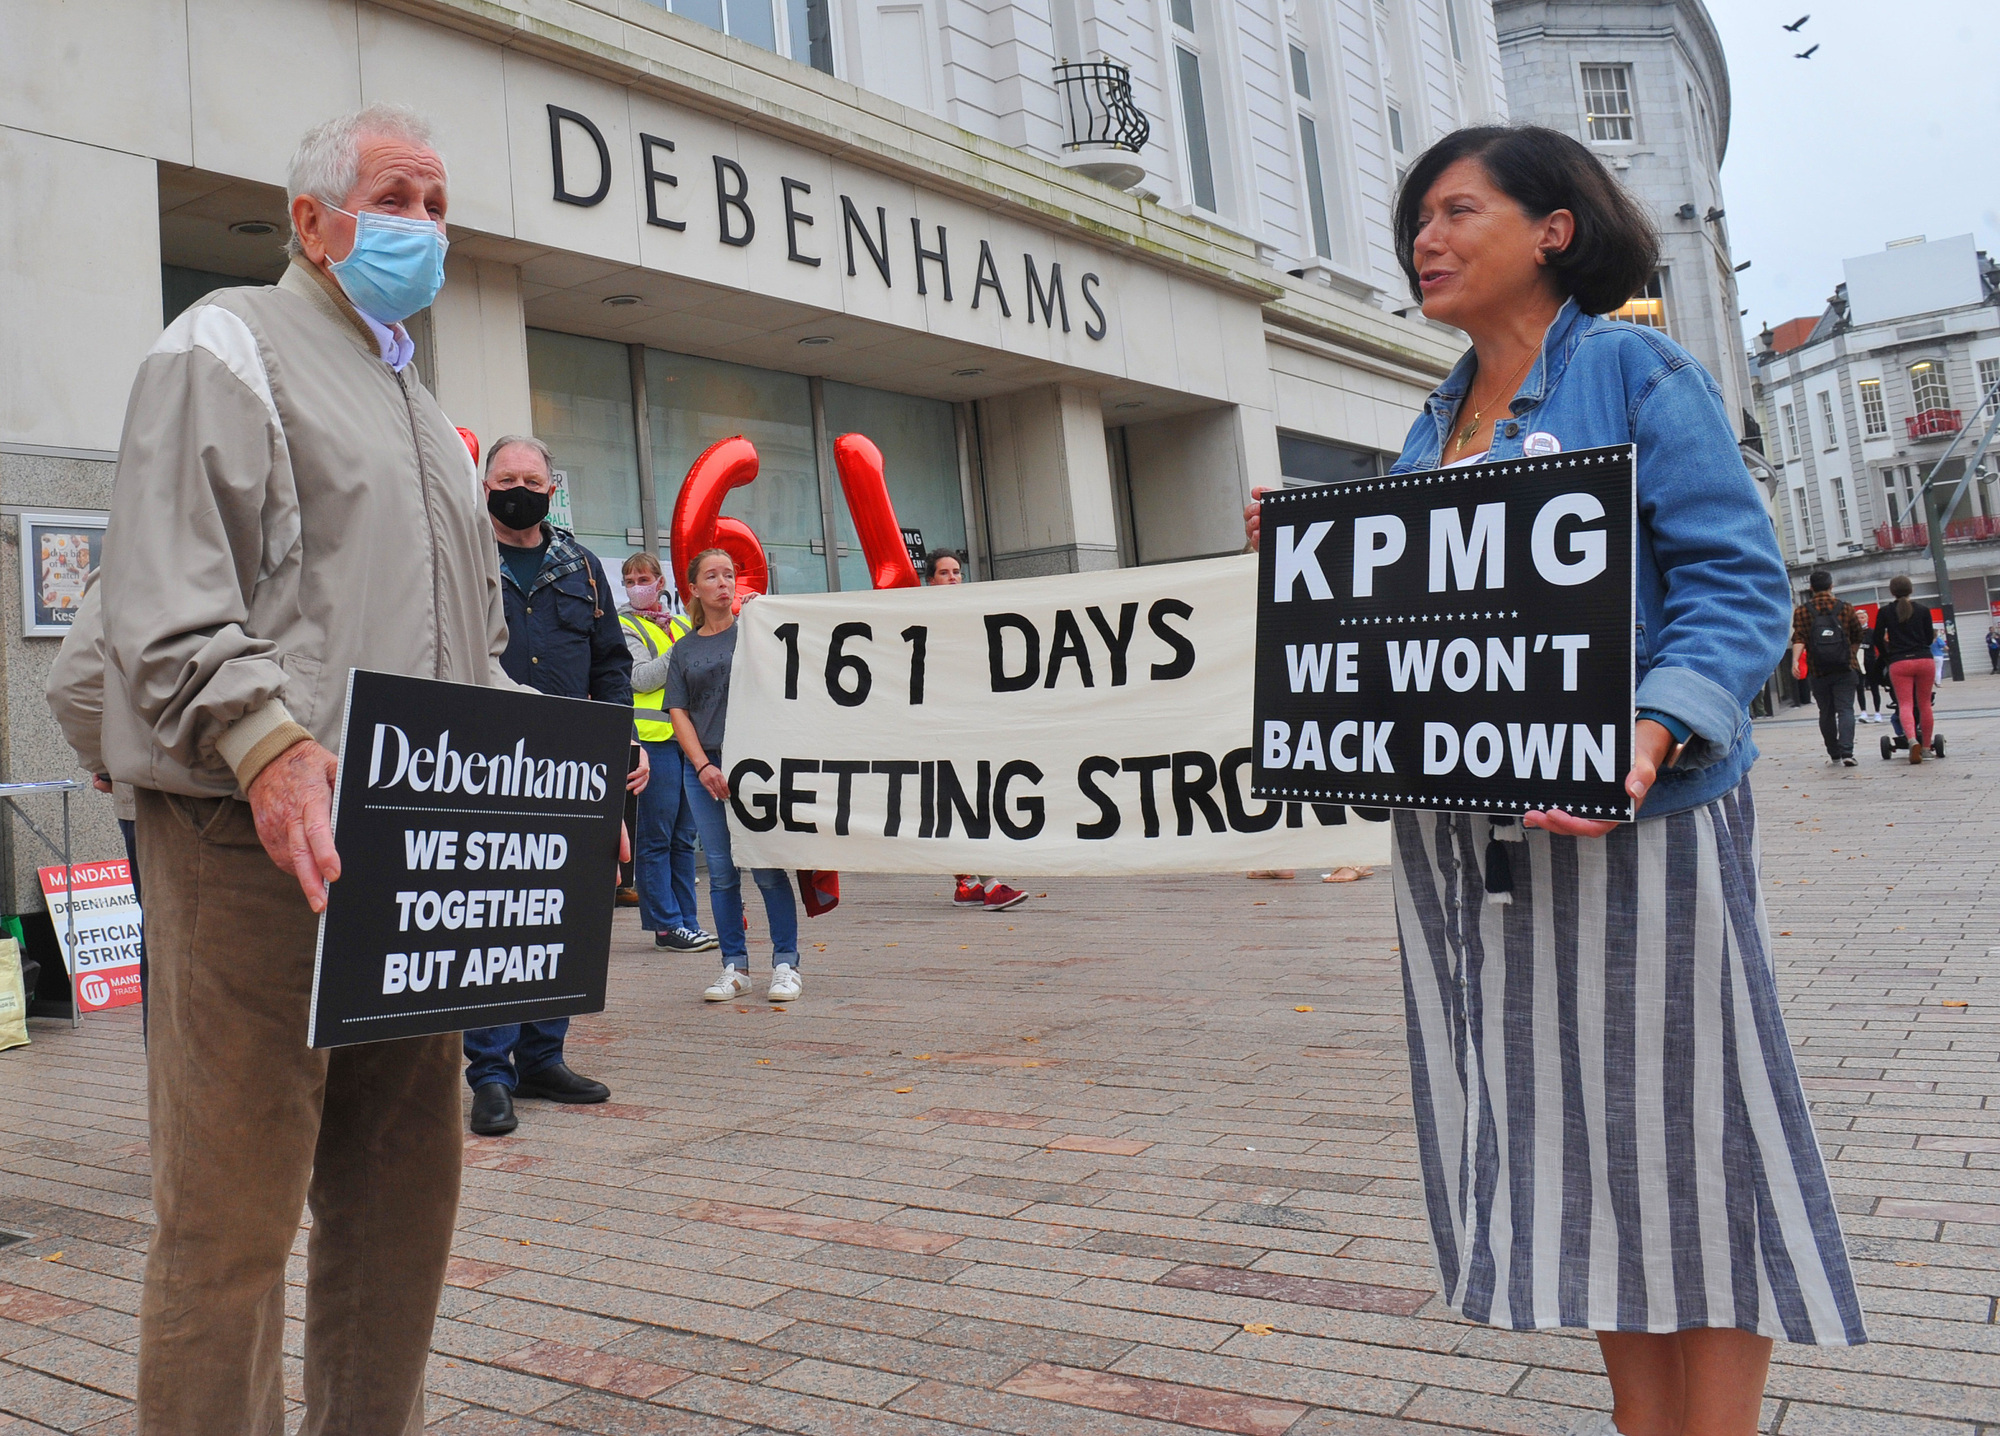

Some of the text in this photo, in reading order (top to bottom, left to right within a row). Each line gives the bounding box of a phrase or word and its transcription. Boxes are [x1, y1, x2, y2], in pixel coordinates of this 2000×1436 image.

[546, 104, 1107, 341] DEBENHAMS
[901, 532, 922, 545] MG
[1274, 492, 1607, 603] KPMG
[774, 598, 1196, 707] 161 DAYS
[1285, 634, 1590, 693] WE WON'T
[368, 723, 607, 802] Debenhams
[1263, 720, 1616, 782] BACK DOWN
[728, 747, 1390, 839] GETTING STRO
[404, 830, 568, 871] WE STAND
[395, 889, 564, 932] TOGETHER
[110, 974, 141, 987] MAND
[382, 943, 564, 995] BUT APART
